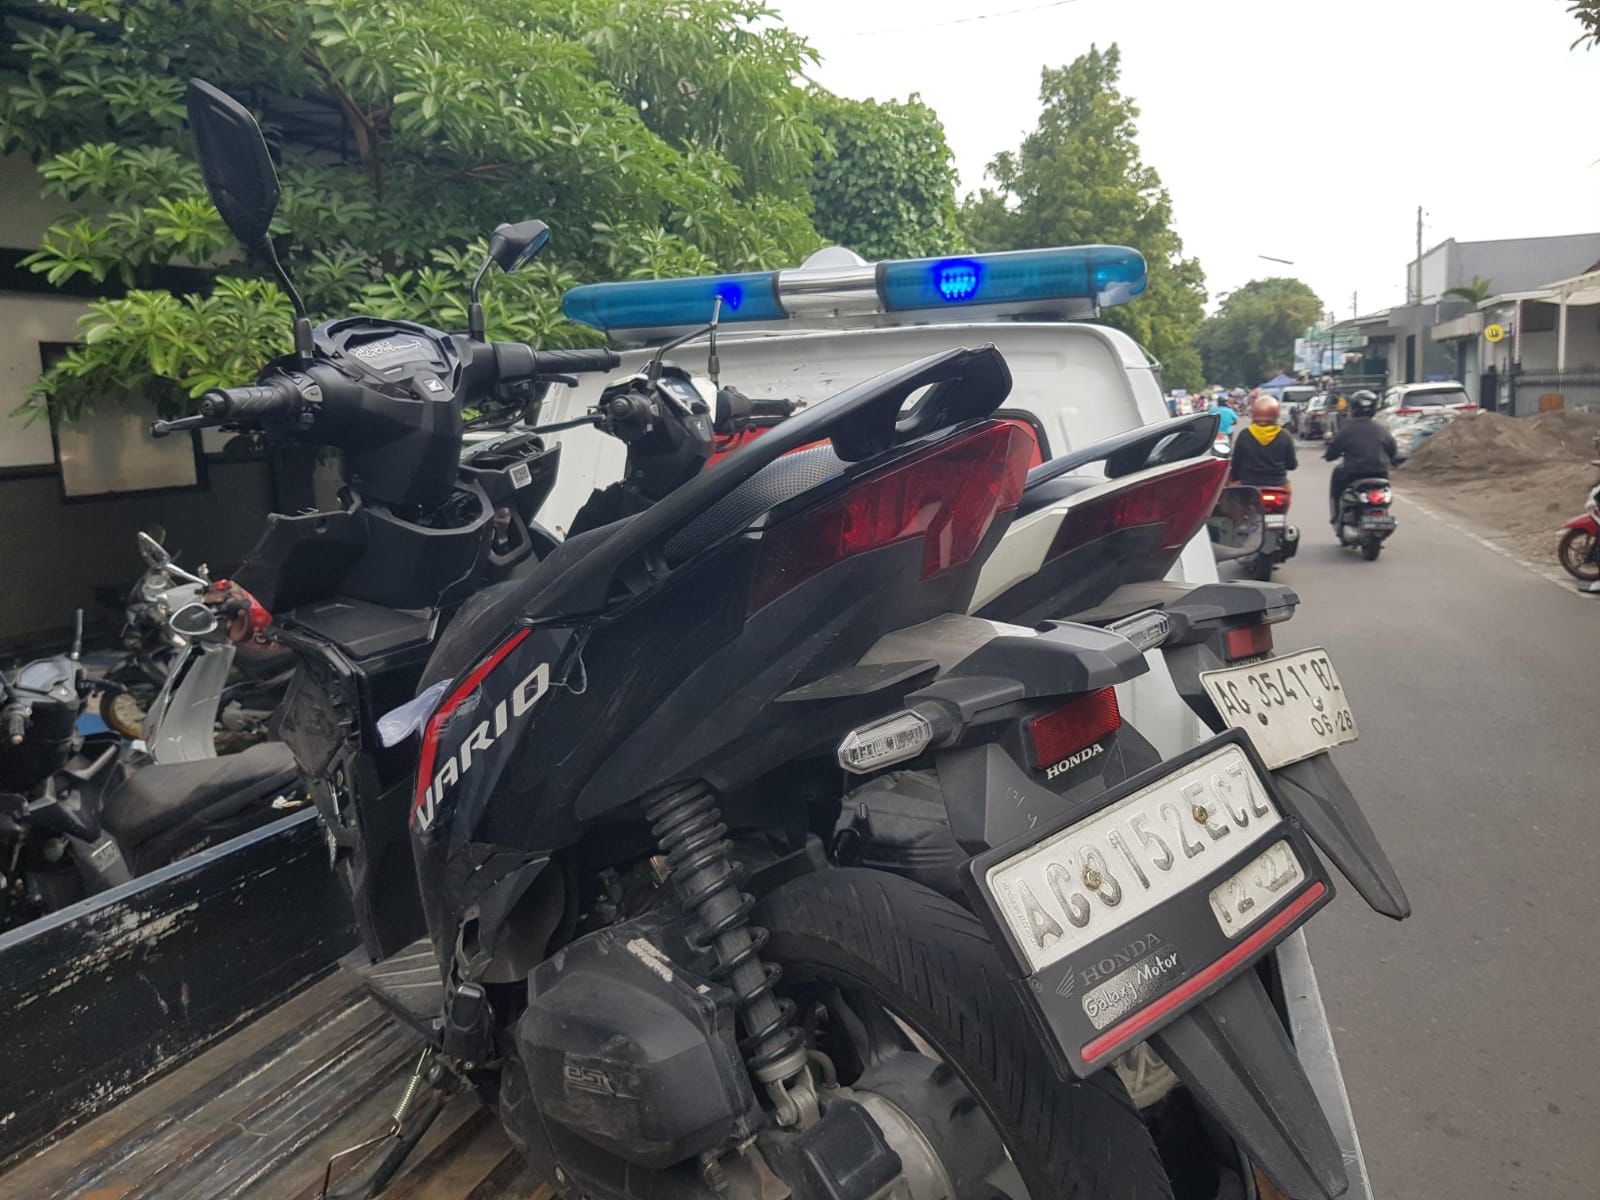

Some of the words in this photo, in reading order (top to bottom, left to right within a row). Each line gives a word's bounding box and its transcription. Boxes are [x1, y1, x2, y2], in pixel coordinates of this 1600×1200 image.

[1213, 680, 1251, 717] AG
[1247, 664, 1311, 708] 3541
[416, 662, 550, 832] VARIO
[1046, 743, 1104, 780] HONDA
[1080, 932, 1162, 987] HONDA
[1084, 981, 1138, 1018] Galaxy
[1136, 952, 1178, 985] Motor
